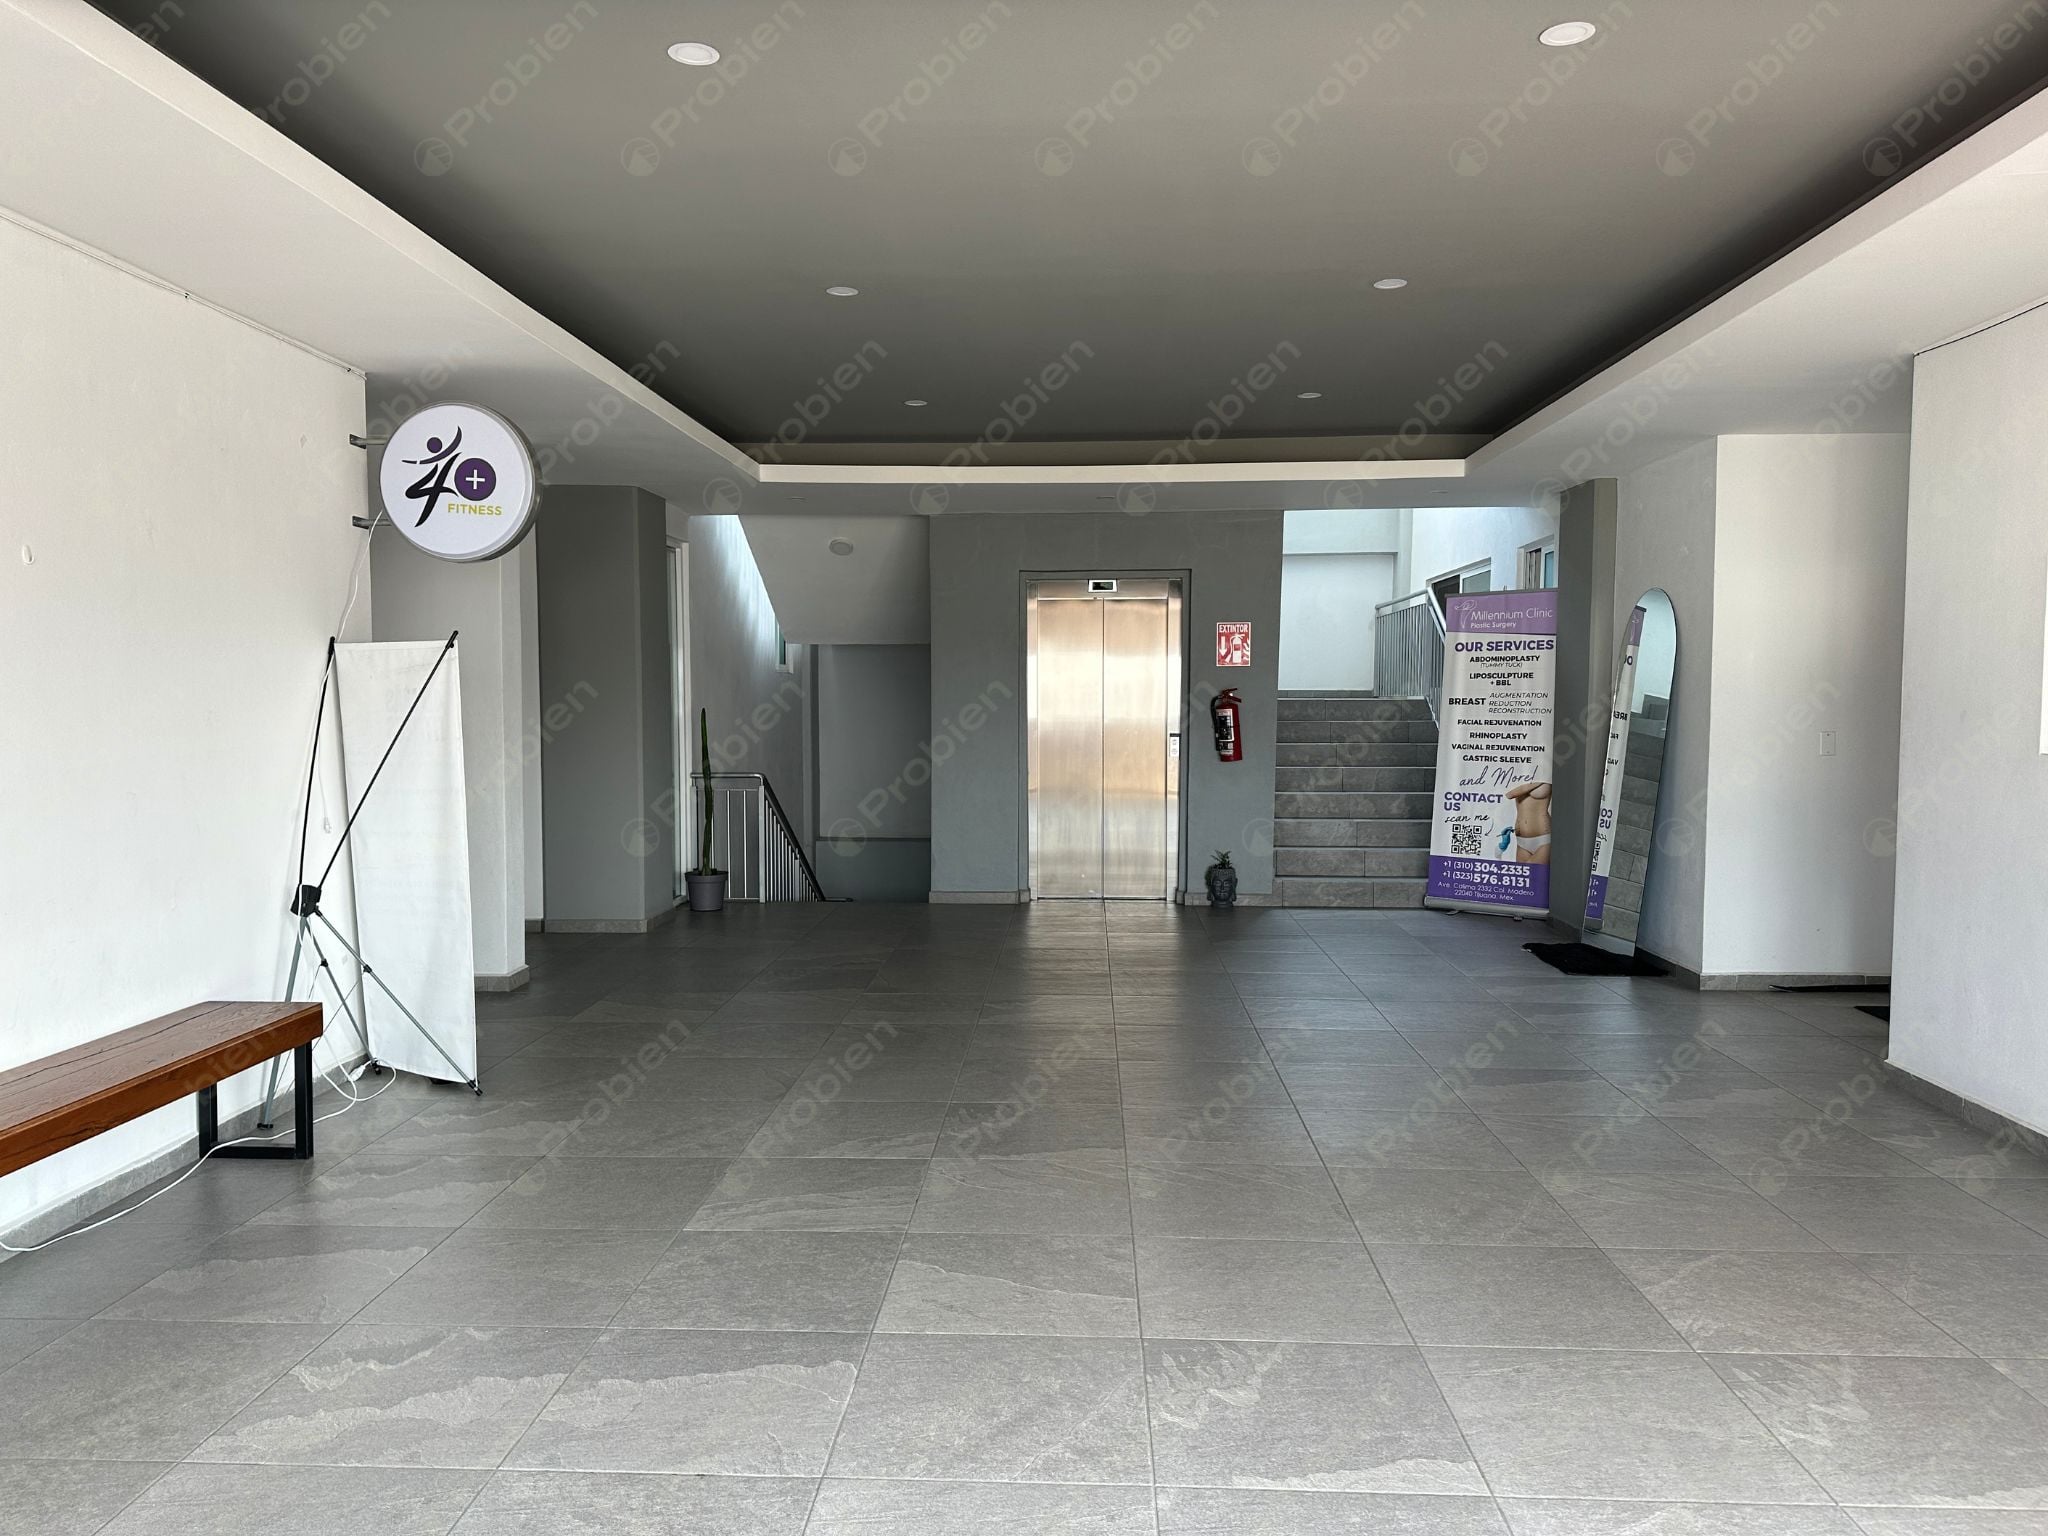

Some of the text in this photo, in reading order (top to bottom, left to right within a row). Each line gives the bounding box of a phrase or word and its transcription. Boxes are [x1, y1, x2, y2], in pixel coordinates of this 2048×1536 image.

[447, 503, 503, 516] FITNESS
[1470, 607, 1553, 621] Millennium Clinic
[1218, 624, 1249, 633] EXTINTOR
[1492, 621, 1517, 629] Surgery
[1455, 640, 1554, 652] OUR SERVICES
[1470, 655, 1540, 663] ABDOMINOPLASTY
[1469, 732, 1528, 740] RHINOPLASTY
[1451, 743, 1545, 752] VAGINAL REJUVENATION
[1462, 755, 1532, 764] GASTRIC SLEEVE
[1459, 765, 1539, 789] and More!
[1444, 791, 1504, 804] CONTACT
[1444, 802, 1461, 811] US
[1444, 815, 1472, 823] scan
[1442, 870, 1451, 878] +1
